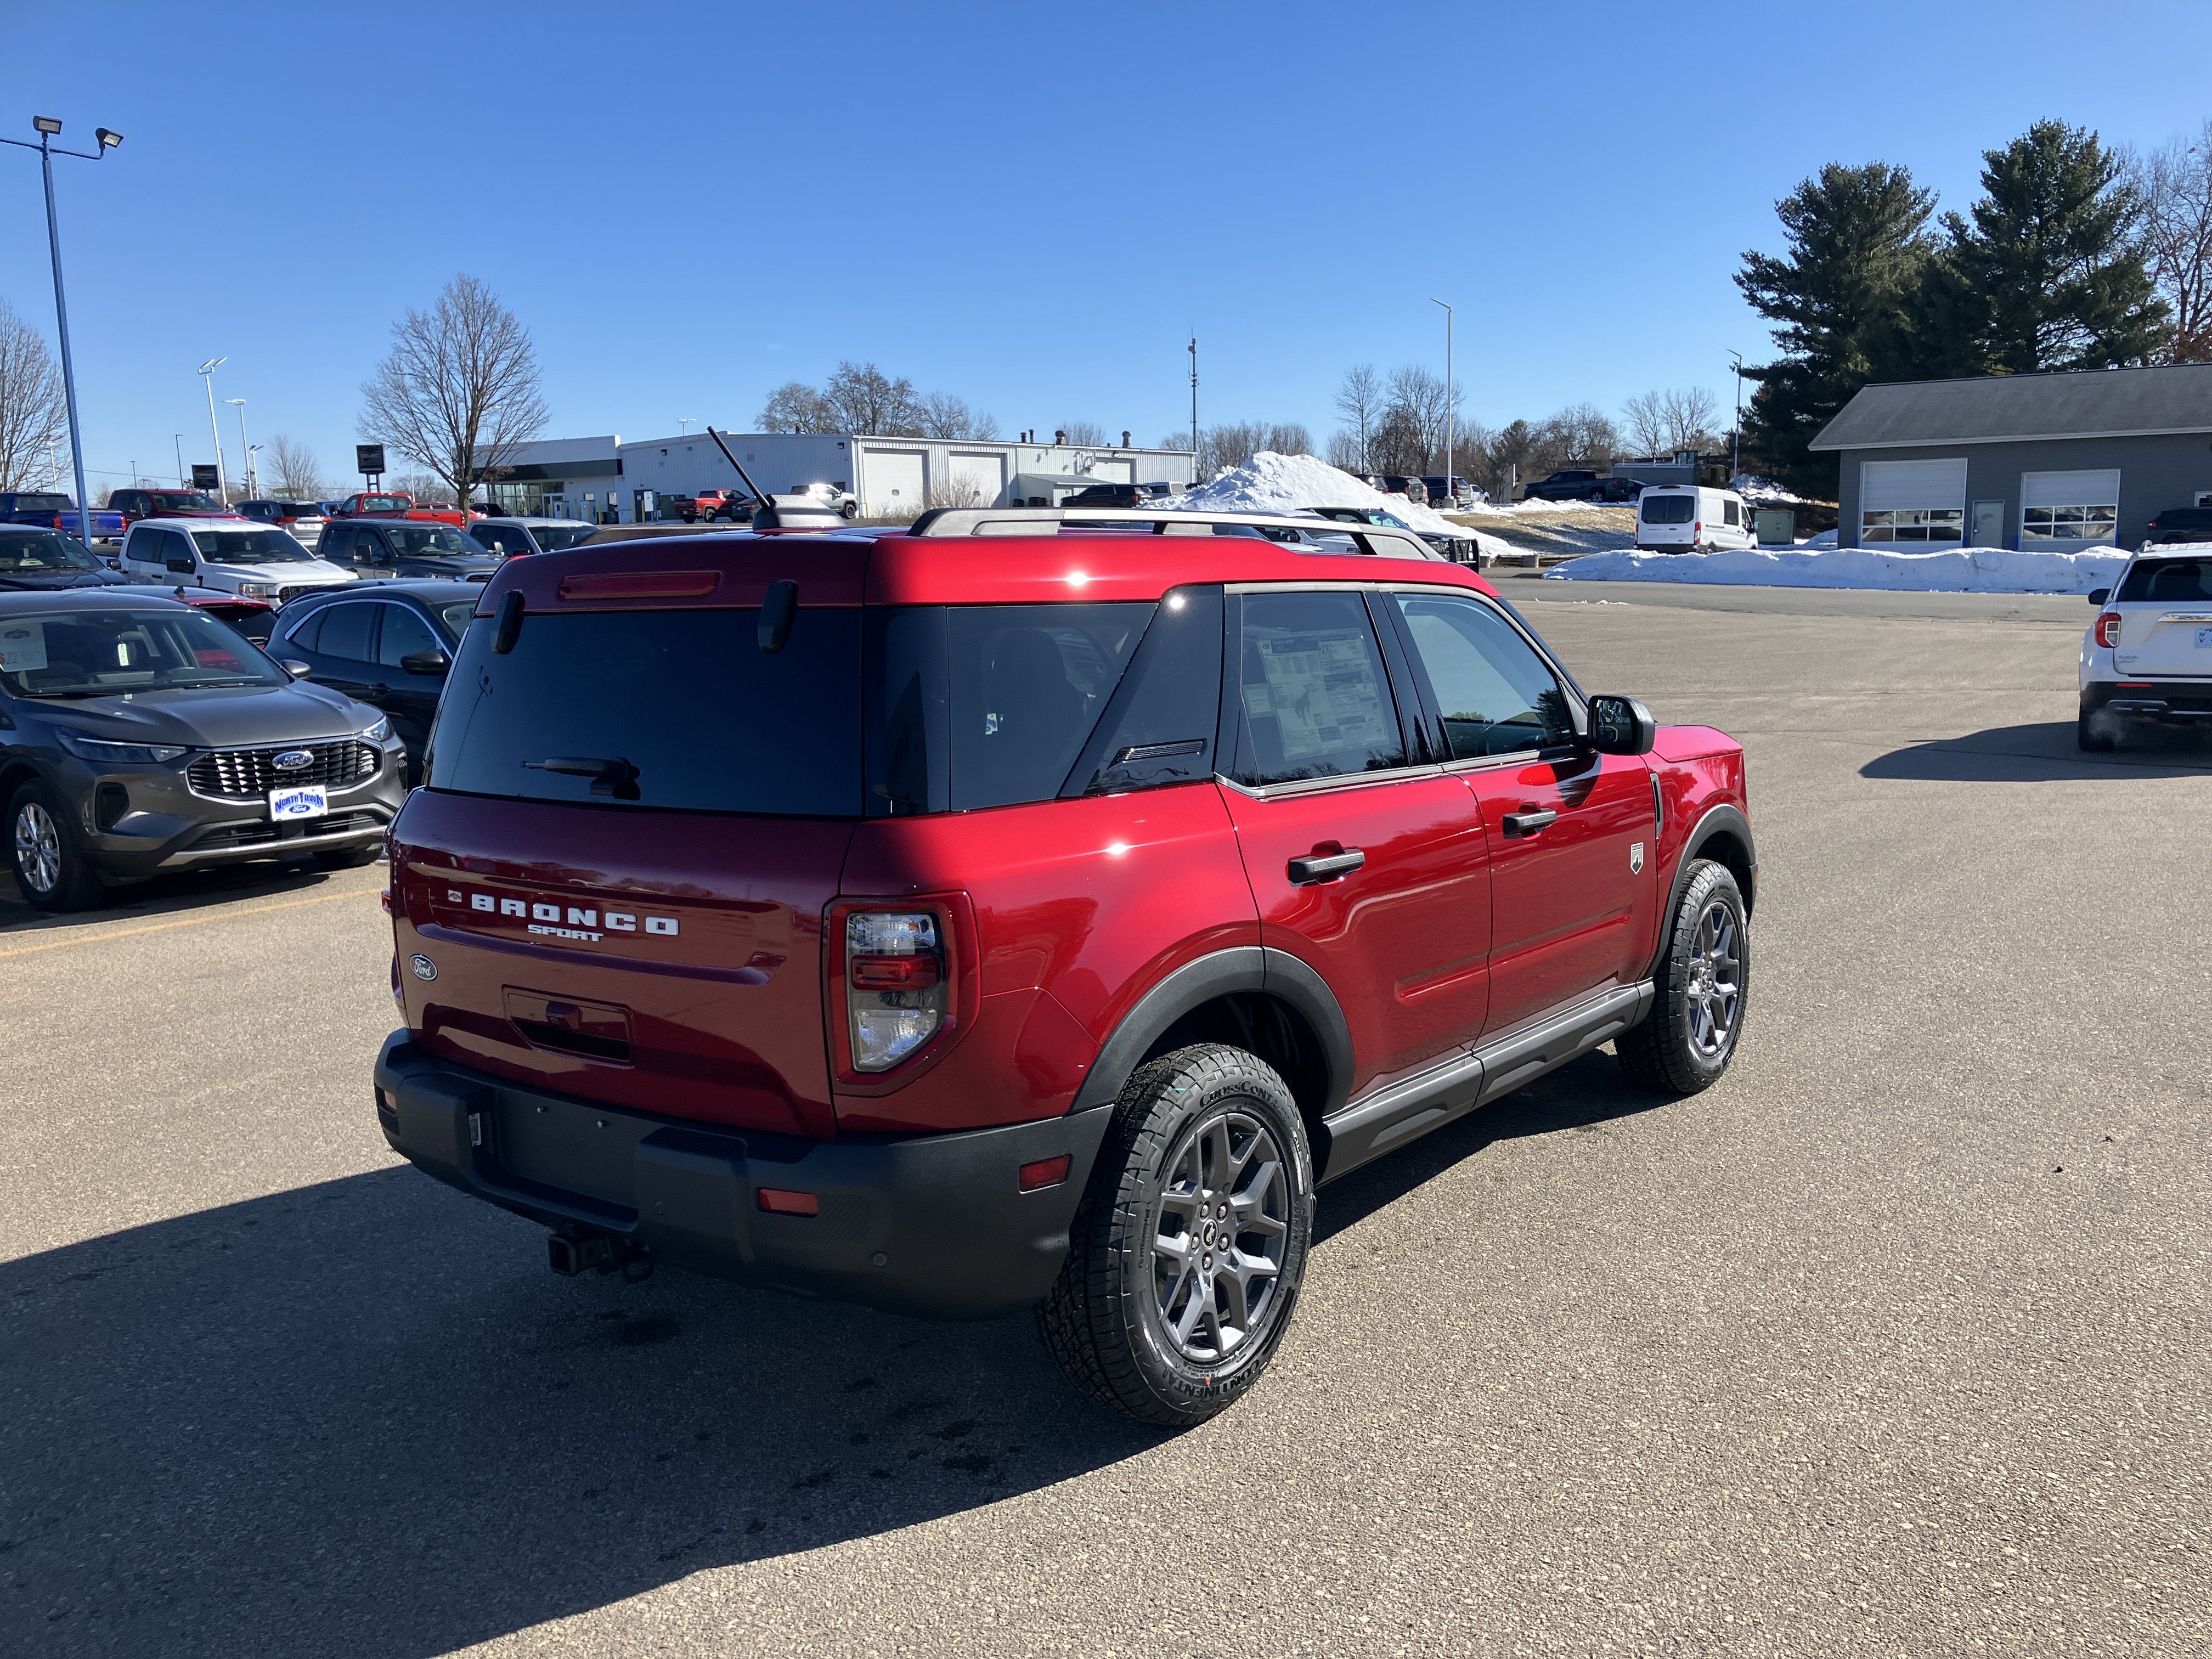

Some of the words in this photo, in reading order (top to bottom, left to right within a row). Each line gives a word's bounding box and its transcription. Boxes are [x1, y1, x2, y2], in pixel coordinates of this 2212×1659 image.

[283, 754, 306, 766] Ford
[471, 893, 680, 936] BRONCO
[528, 924, 604, 942] SPORT
[414, 958, 432, 977] Ford
[1161, 1359, 1260, 1398] CONTINENTAL
